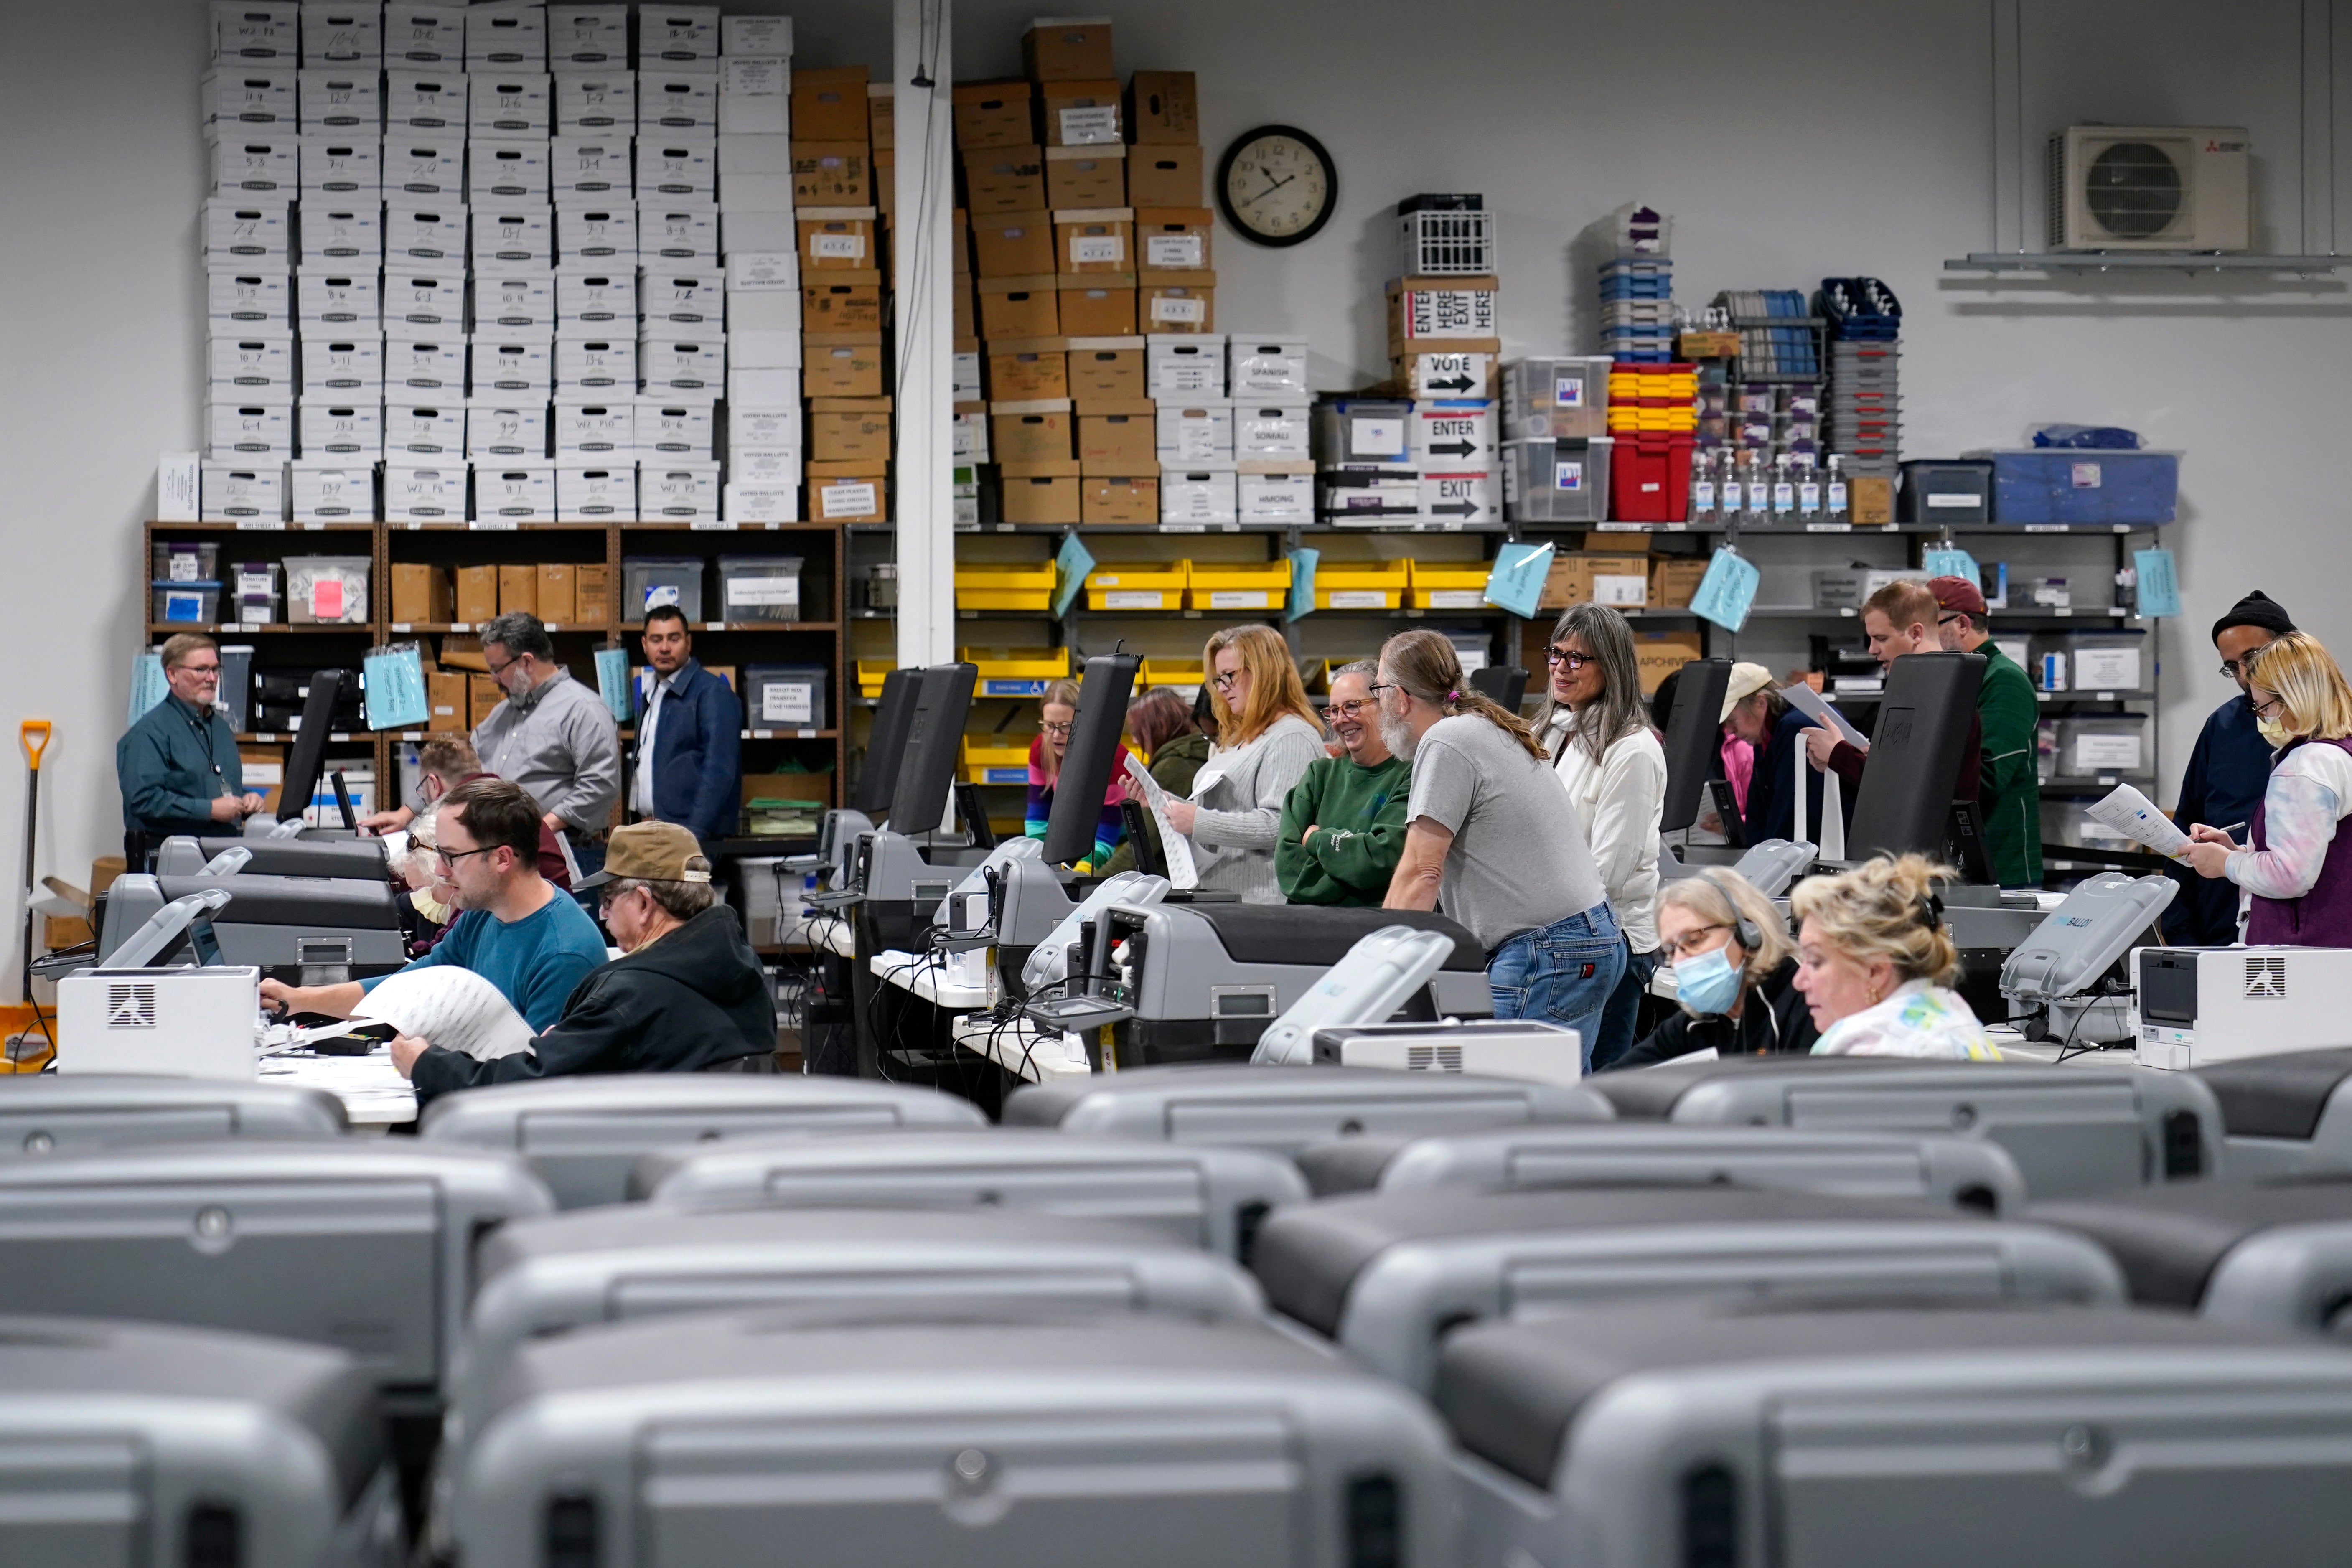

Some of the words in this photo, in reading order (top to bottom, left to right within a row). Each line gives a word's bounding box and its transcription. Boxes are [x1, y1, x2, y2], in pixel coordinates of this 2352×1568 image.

[1437, 290, 1452, 328] HERE
[1454, 294, 1469, 325] EXIT
[1475, 290, 1491, 328] HERE
[1431, 357, 1470, 371] VOTE
[1251, 368, 1289, 376] SPANISH
[1254, 431, 1289, 440] SOMALI
[1433, 421, 1474, 436] ENTER
[1440, 481, 1472, 497] EXIT
[1258, 494, 1294, 503] HMONG
[1640, 656, 1696, 668] ARCHIVE
